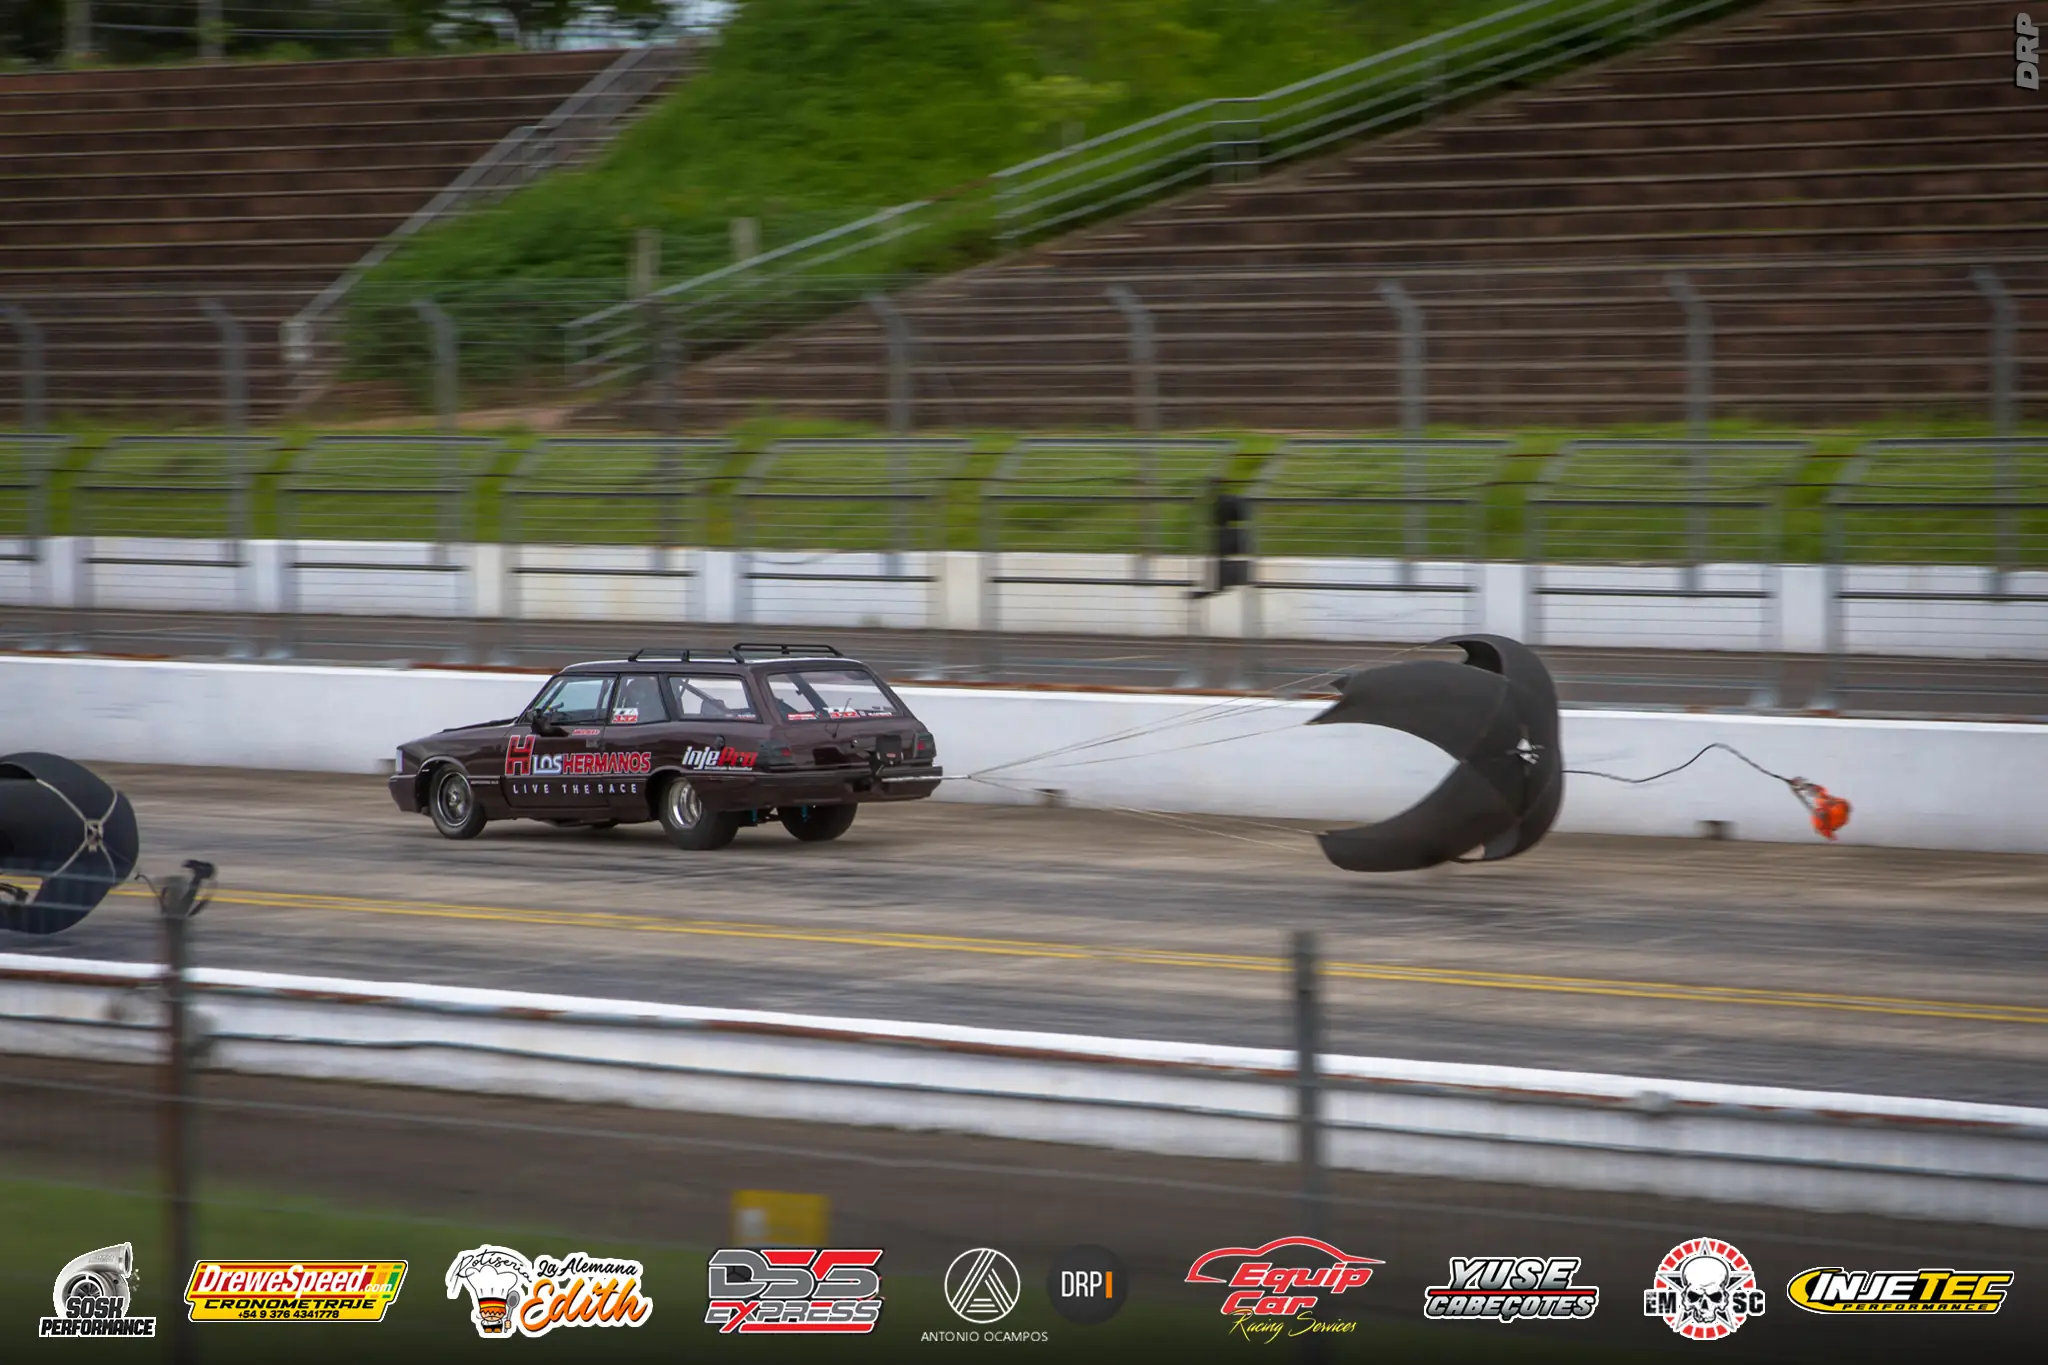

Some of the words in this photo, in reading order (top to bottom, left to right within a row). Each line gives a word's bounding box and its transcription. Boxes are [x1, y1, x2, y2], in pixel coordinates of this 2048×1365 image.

[562, 752, 651, 775] HERMANOS
[513, 784, 549, 794] LIVE
[562, 784, 590, 794] THE
[598, 784, 636, 794] RACE
